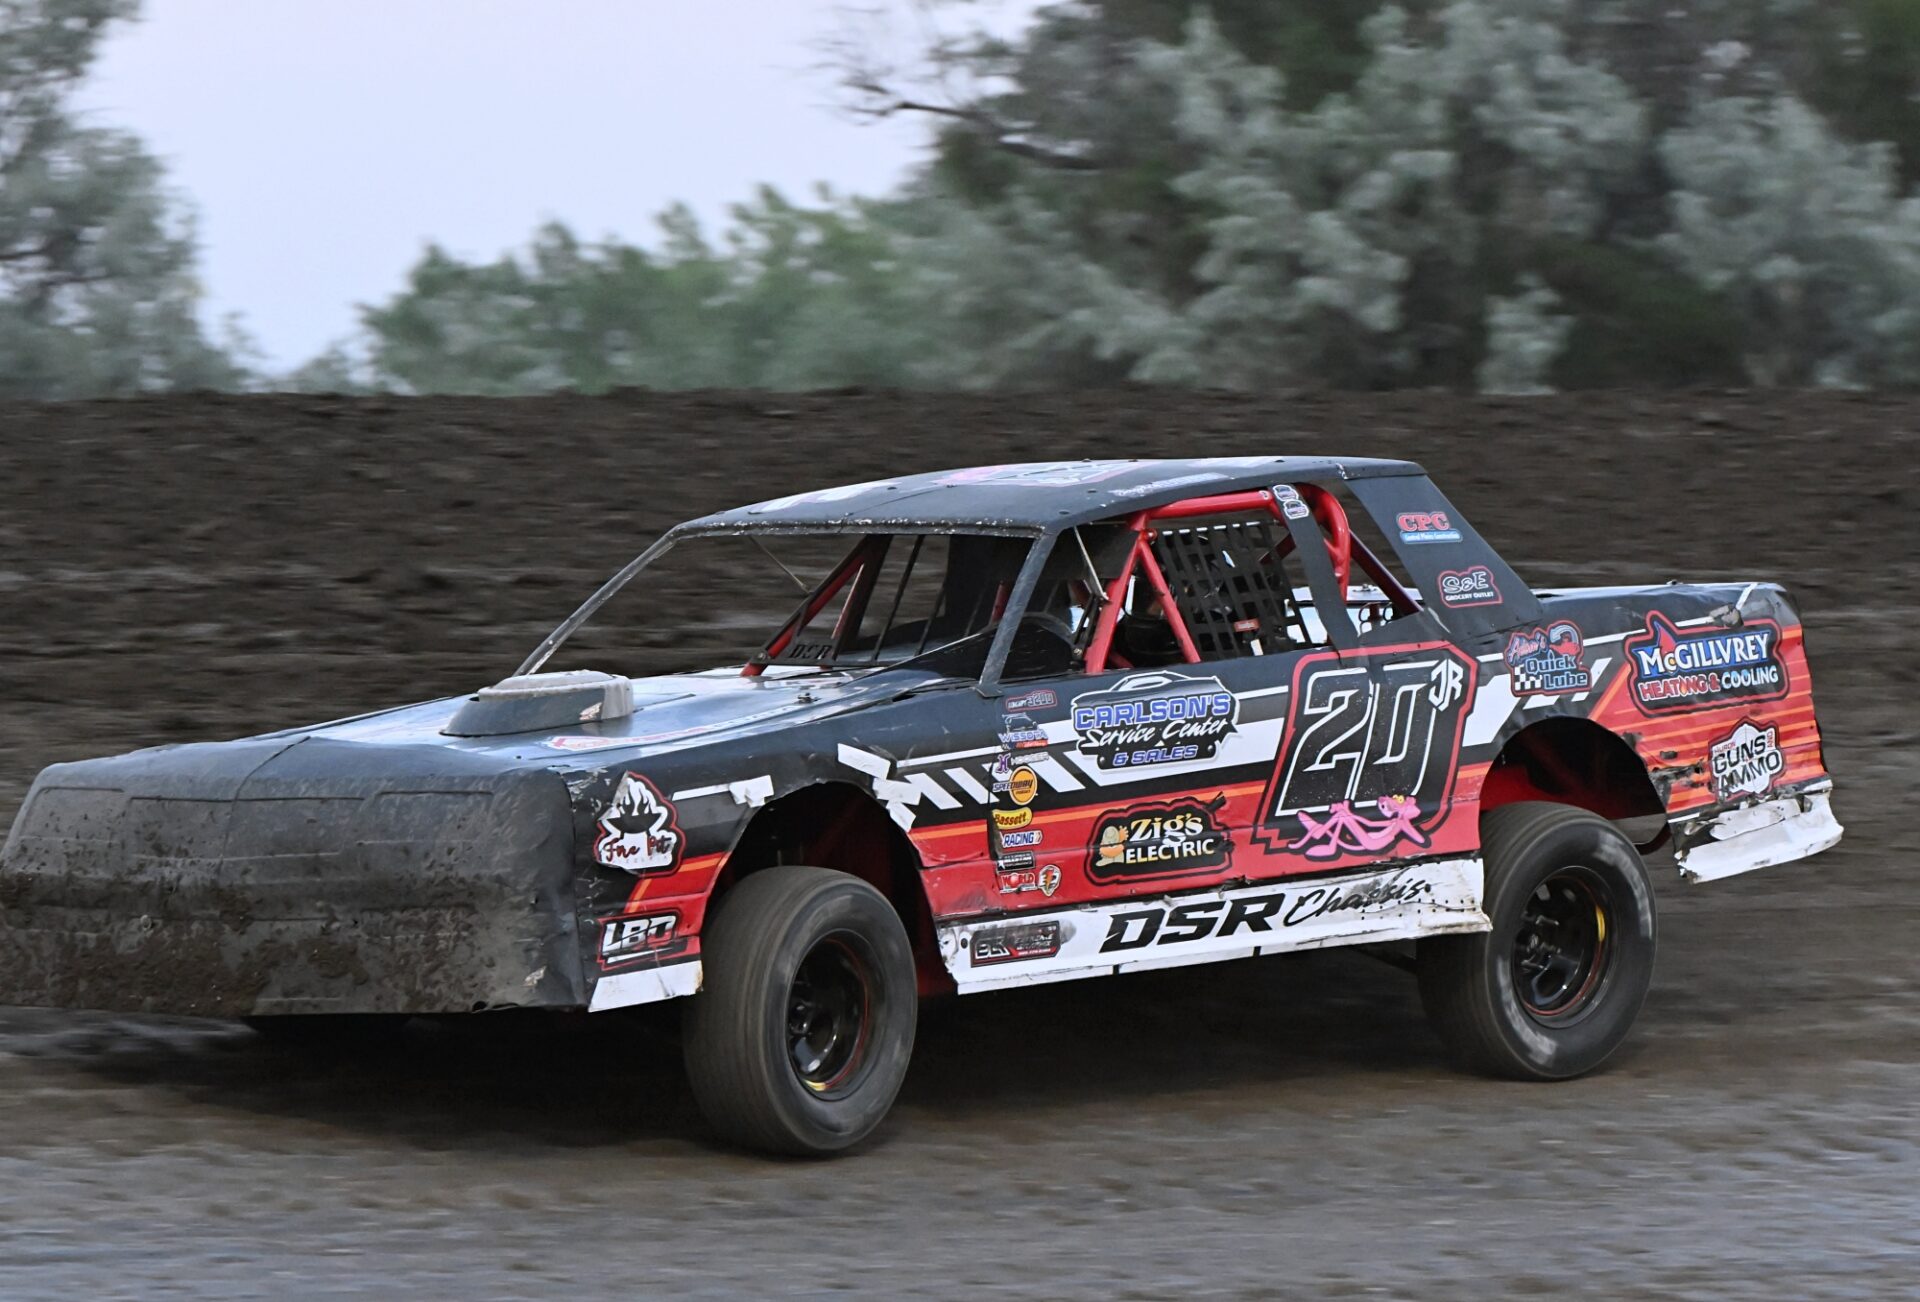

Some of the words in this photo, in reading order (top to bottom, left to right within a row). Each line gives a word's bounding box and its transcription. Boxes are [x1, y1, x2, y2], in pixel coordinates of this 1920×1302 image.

[1398, 512, 1450, 532] CPC
[1445, 593, 1473, 601] GROCERY
[1473, 591, 1494, 599] OUTLET
[1525, 653, 1577, 675] Quick
[1427, 659, 1464, 712] JR
[1543, 671, 1588, 690] Lube
[1638, 675, 1708, 701] HEATING
[1709, 672, 1722, 693] &
[1721, 665, 1779, 690] COOLING
[1075, 693, 1231, 730] CARLSON'S
[998, 729, 1048, 742] WISSOTA
[1080, 724, 1156, 748] Service
[1161, 717, 1229, 739] Center
[1113, 753, 1129, 766] &
[1130, 745, 1199, 765] SALES
[1713, 734, 1766, 774] GUNS
[1721, 750, 1780, 794] AMMO
[992, 779, 1034, 793] SPEEDWAY
[995, 811, 1028, 826] Bassett
[1003, 831, 1035, 847] RACING
[1129, 813, 1204, 849] Zig's
[1126, 838, 1215, 864] ELECTRIC
[1099, 893, 1286, 954] DSR
